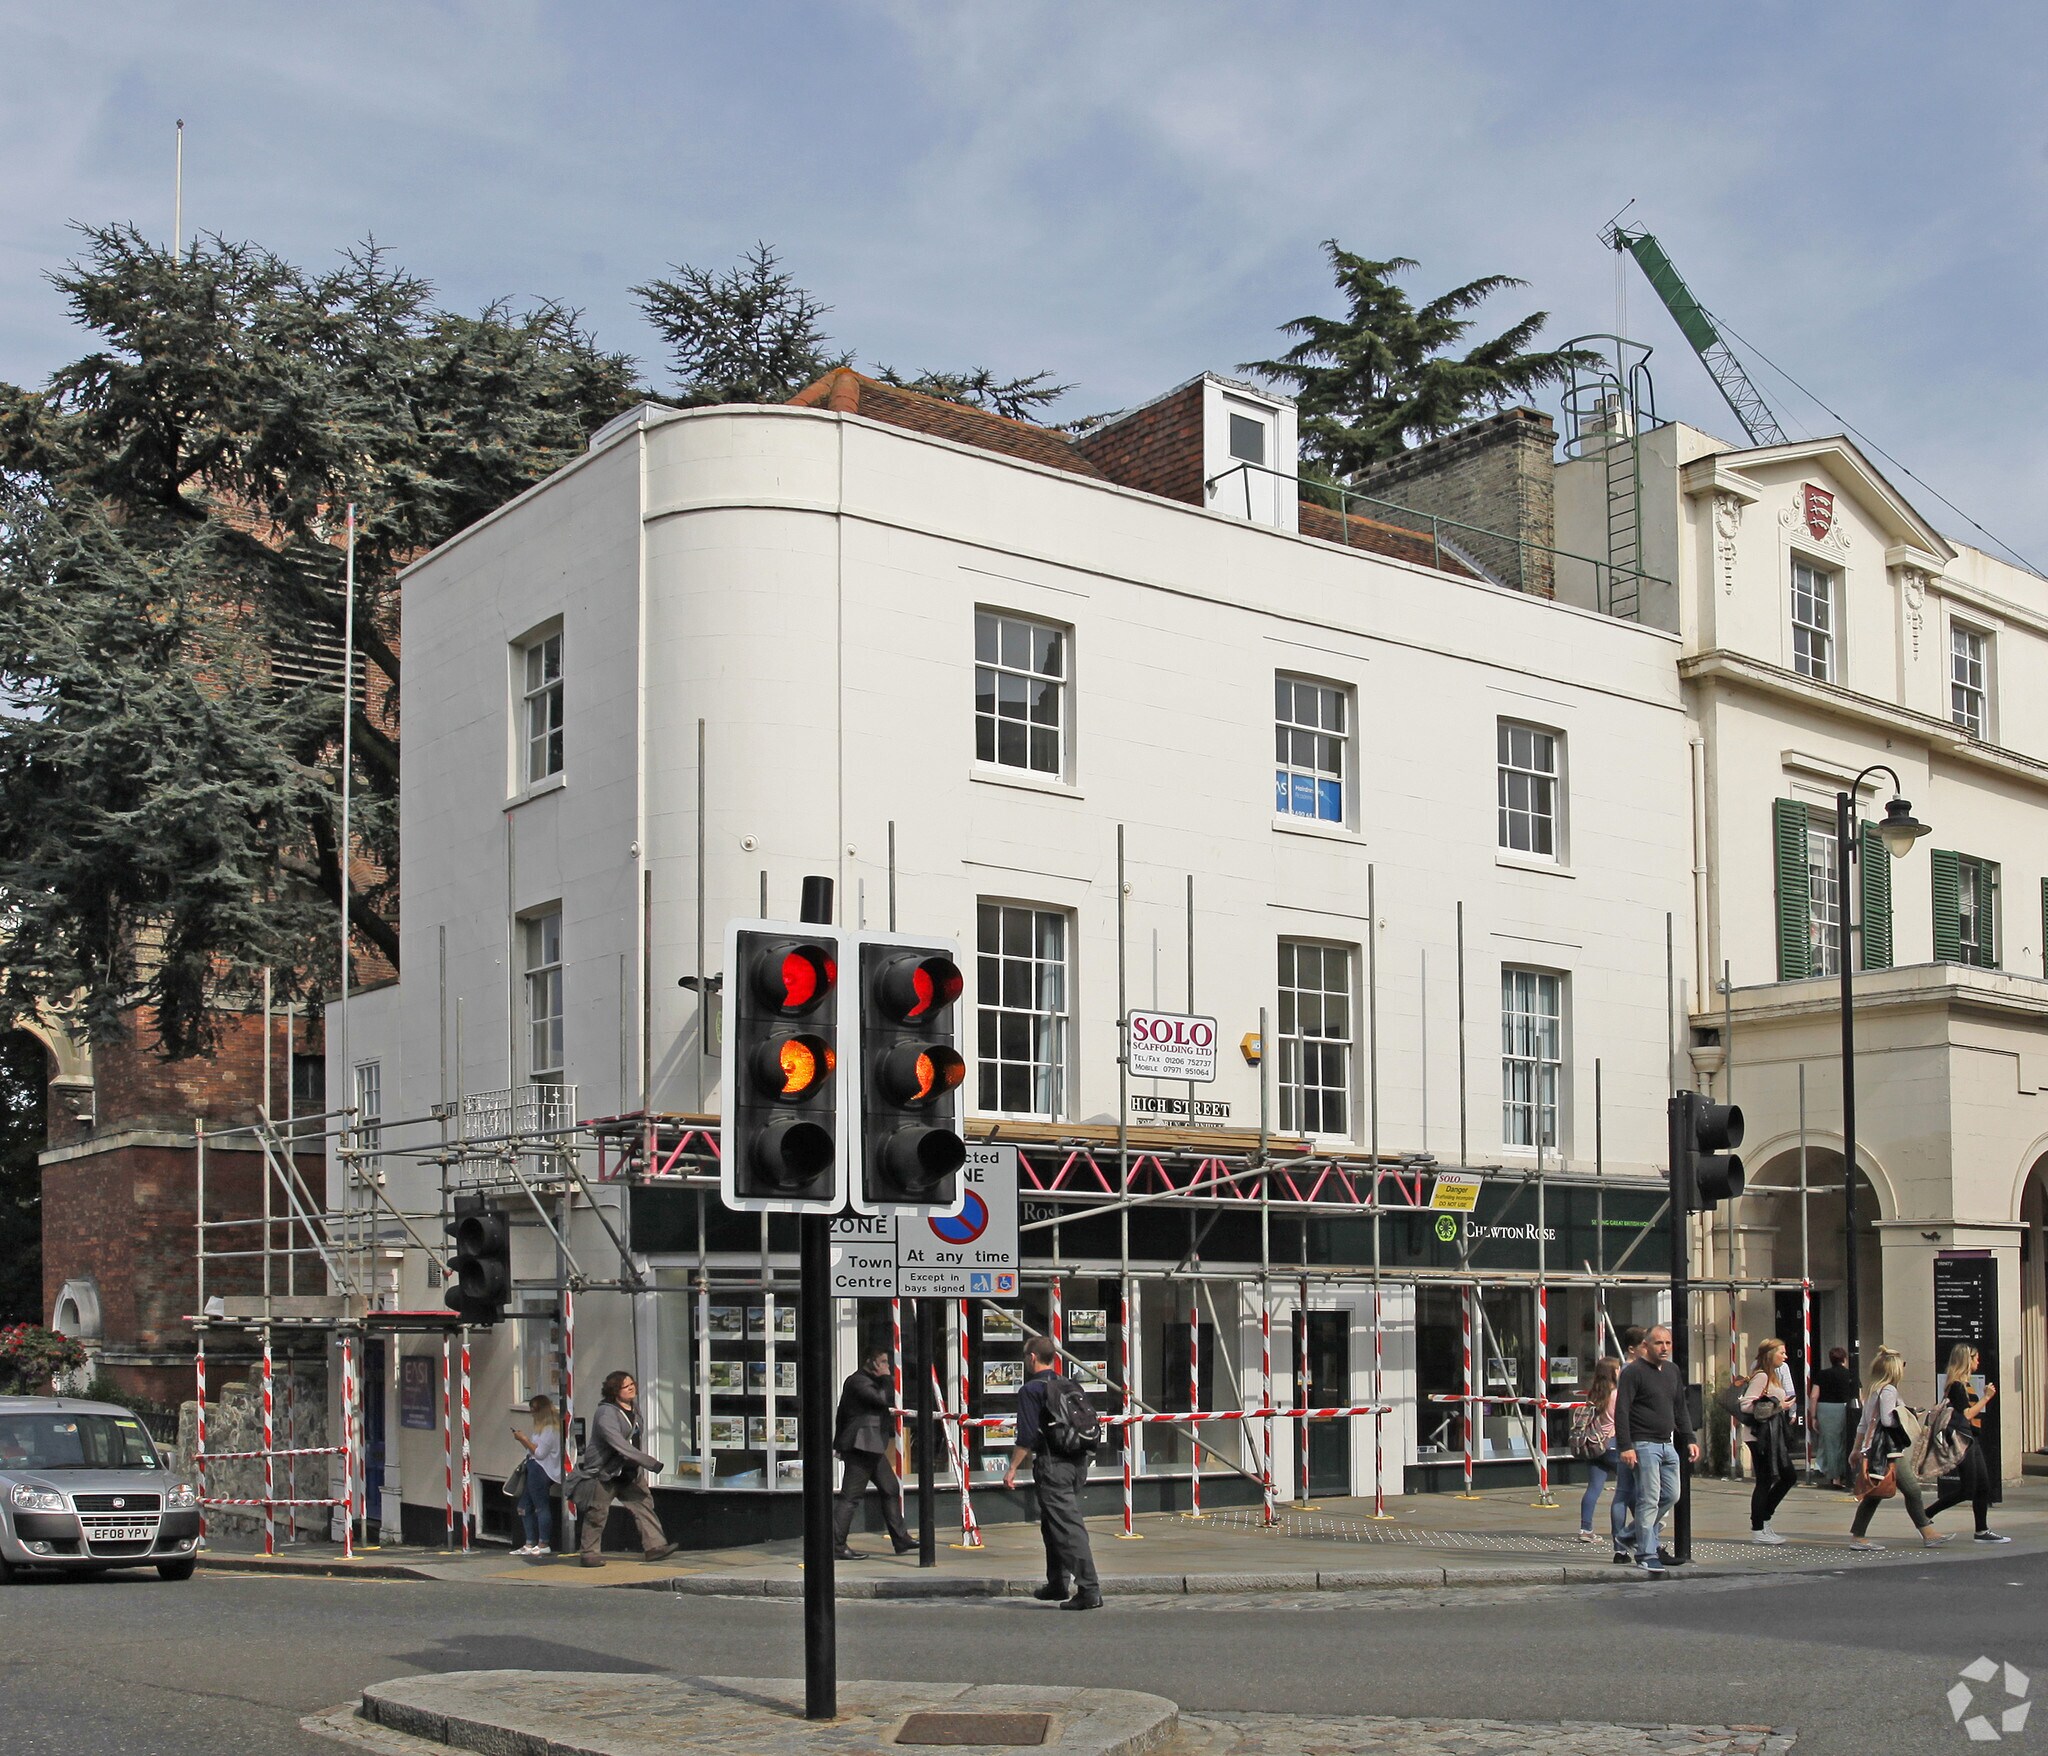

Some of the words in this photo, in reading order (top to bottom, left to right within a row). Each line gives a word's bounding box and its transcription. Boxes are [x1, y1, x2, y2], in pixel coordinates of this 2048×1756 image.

[1133, 1017, 1213, 1047] SOLO
[1133, 1042, 1194, 1055] SCAFFOLDING
[1196, 1047, 1212, 1056] LTD
[1165, 1057, 1185, 1065] 01206
[1187, 1059, 1212, 1067] 752737
[1132, 1097, 1166, 1112] HIGH
[1173, 1100, 1230, 1117] STREET
[1439, 1175, 1461, 1184] SOLO
[1446, 1186, 1468, 1195] Danger
[830, 1217, 887, 1234] ZONE
[848, 1256, 892, 1268] Town
[907, 1249, 925, 1262] At
[936, 1252, 963, 1265] any
[975, 1250, 1010, 1263] time
[835, 1275, 892, 1288] Centre
[910, 1273, 945, 1283] Except
[904, 1284, 927, 1293] bays
[933, 1284, 965, 1294] signed
[94, 1529, 124, 1539] EF08
[127, 1528, 149, 1538] YPV
